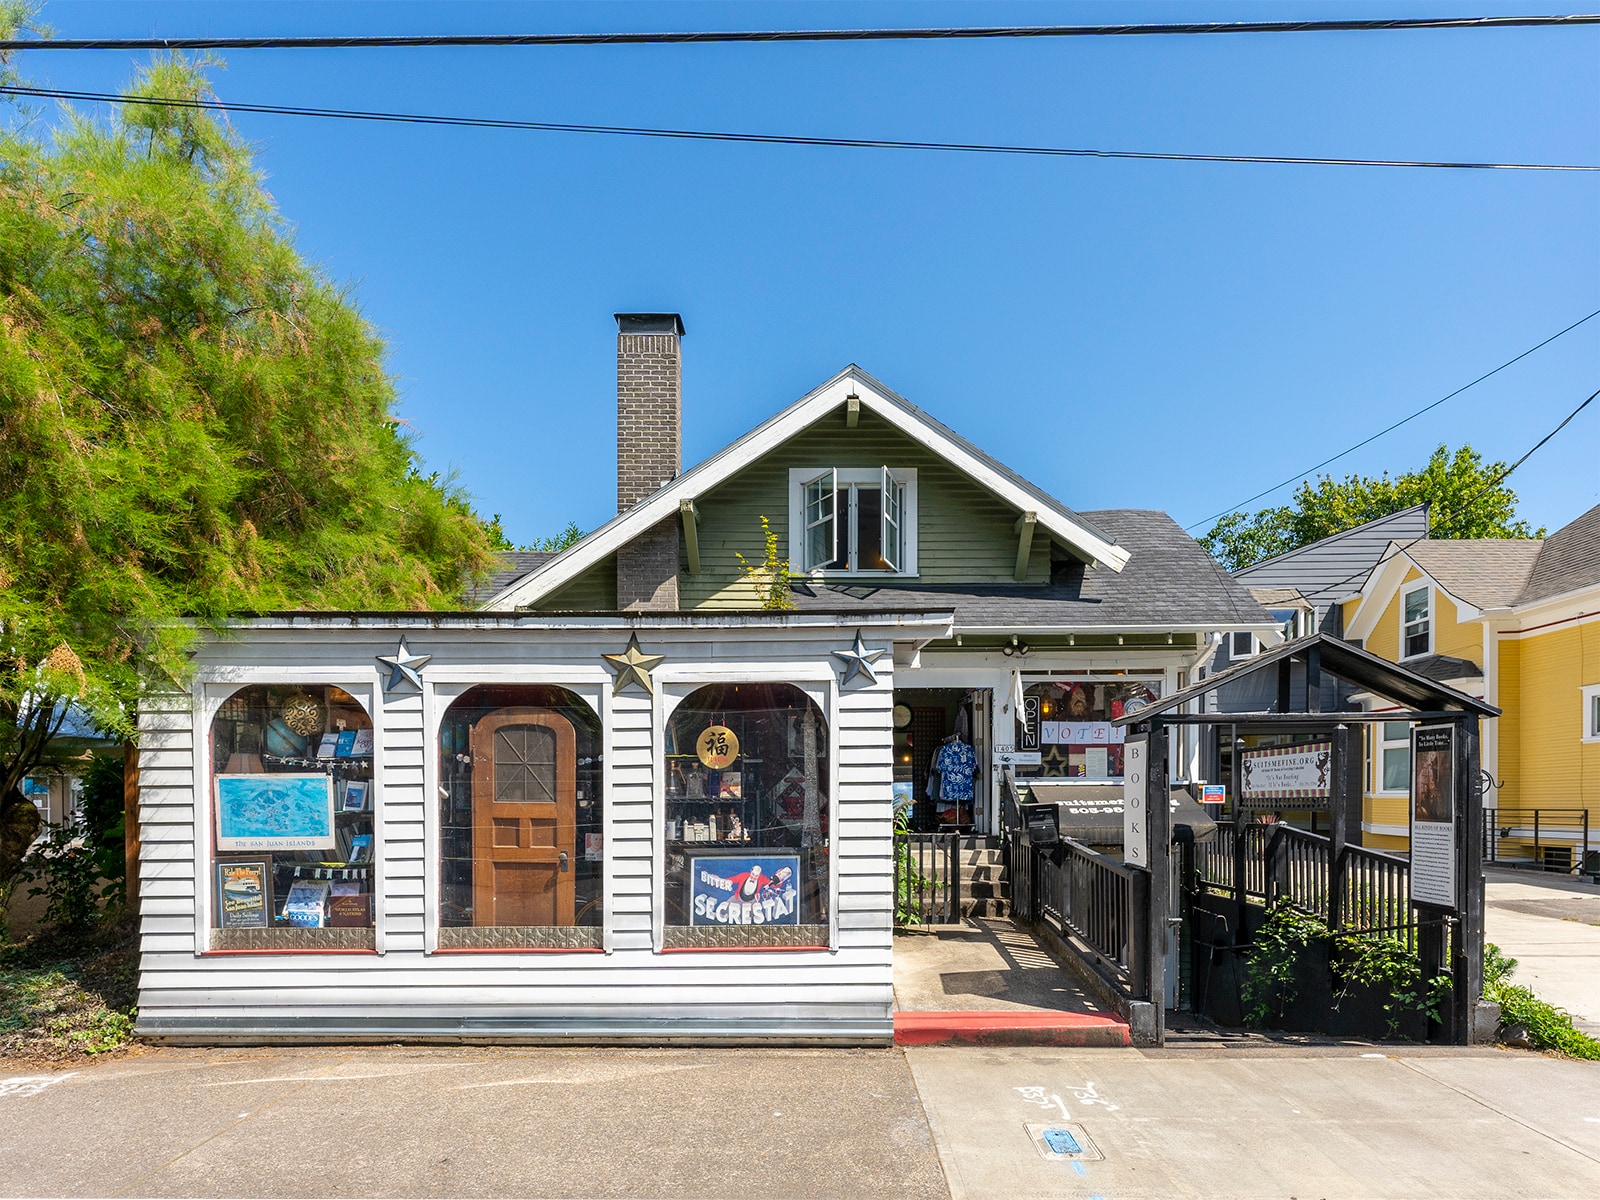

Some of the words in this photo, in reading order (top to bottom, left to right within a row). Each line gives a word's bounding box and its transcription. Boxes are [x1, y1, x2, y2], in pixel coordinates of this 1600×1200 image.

[1024, 698, 1037, 746] OPEN
[704, 731, 729, 756] 福
[1253, 756, 1315, 769] SUITSMEFINE.ORG
[1130, 747, 1140, 859] BOOKS
[701, 870, 733, 892] BITTER
[695, 889, 796, 925] SECRESTAT
